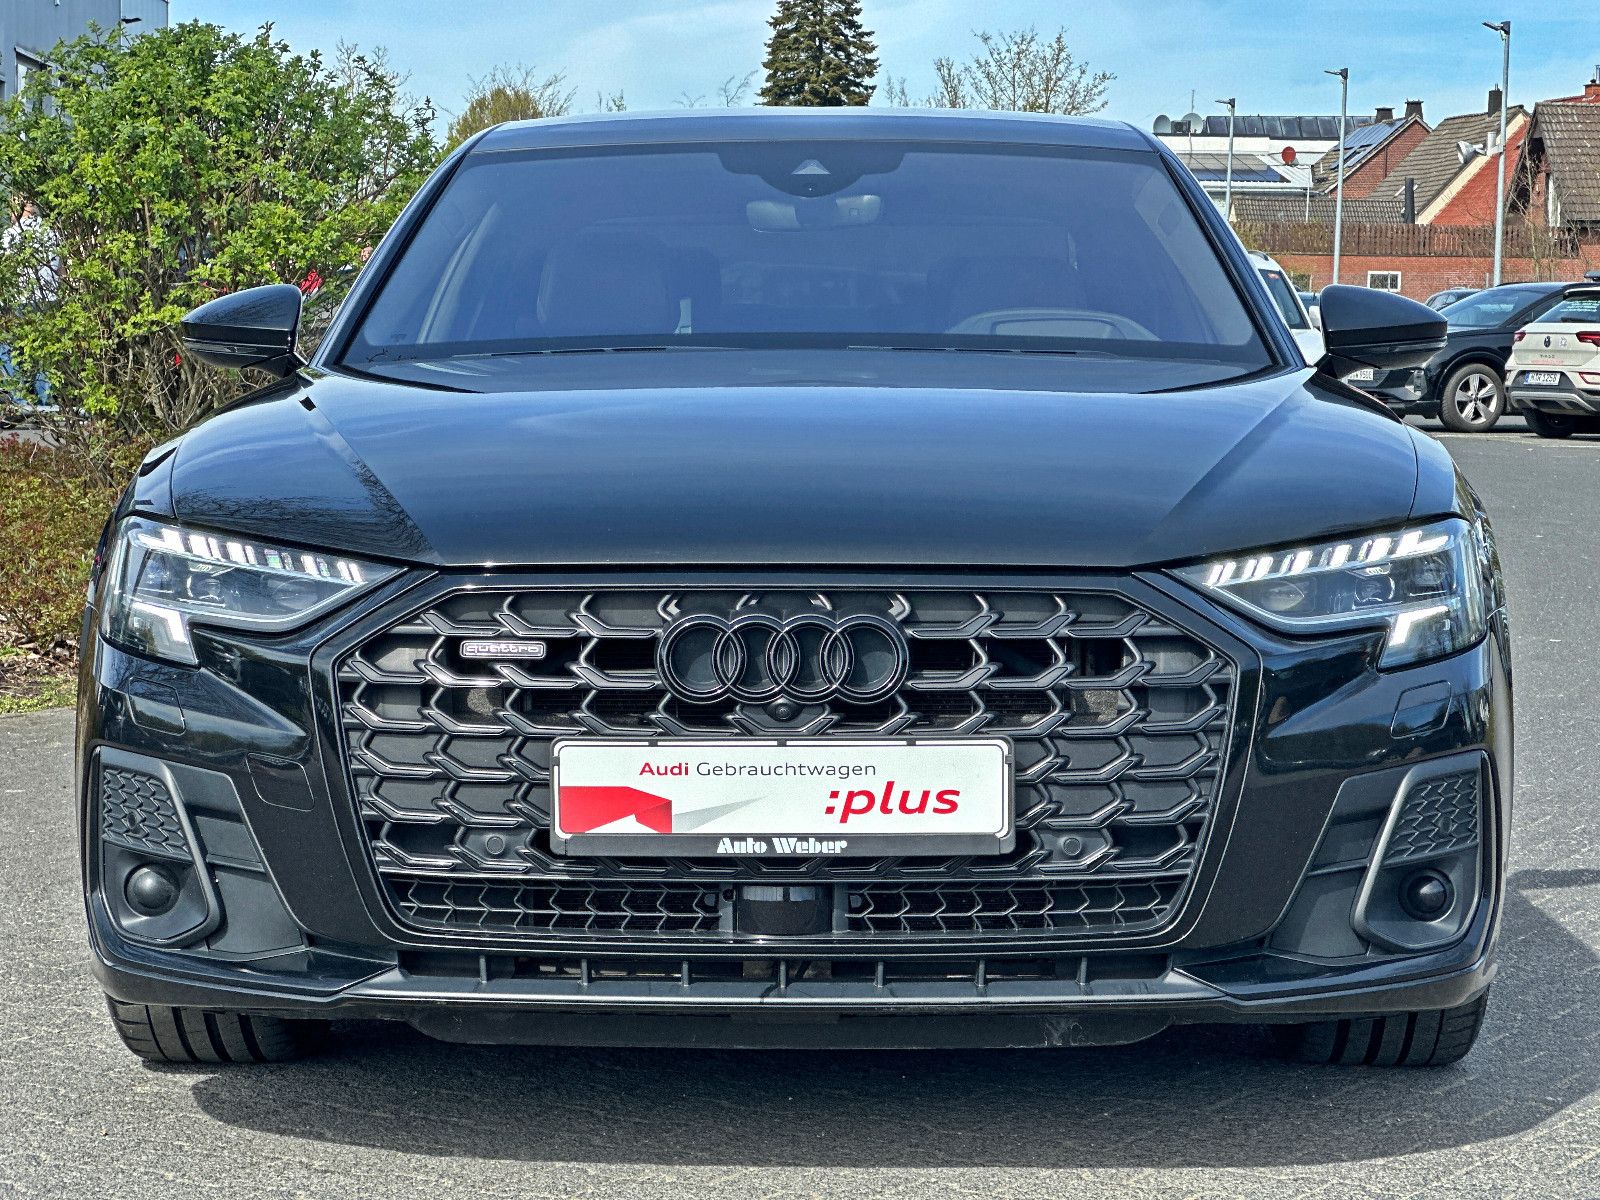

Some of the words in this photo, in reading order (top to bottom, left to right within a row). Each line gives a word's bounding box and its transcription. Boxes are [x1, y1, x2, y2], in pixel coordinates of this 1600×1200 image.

[466, 644, 539, 654] quattro
[639, 762, 689, 776] Audi
[696, 762, 876, 780] Gebrauchtwagen
[824, 780, 961, 824] :plus
[716, 837, 768, 854] Auto
[771, 837, 848, 854] Weber
